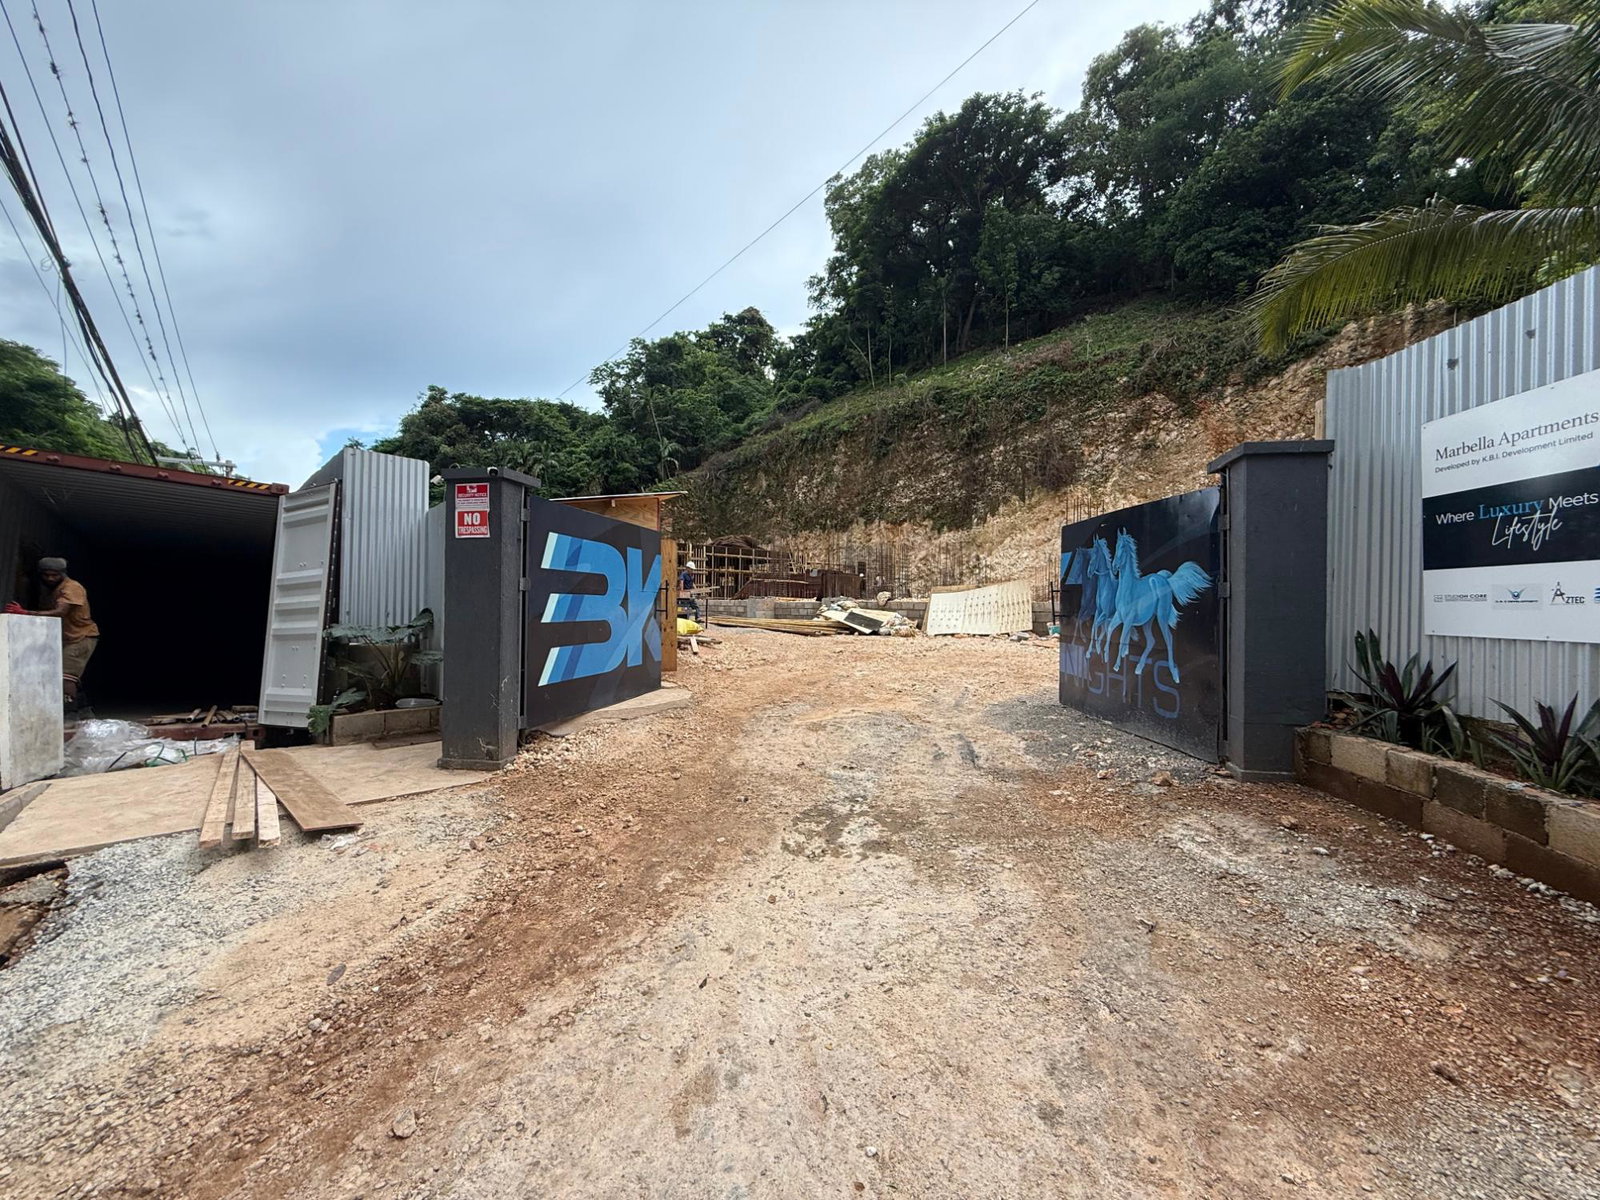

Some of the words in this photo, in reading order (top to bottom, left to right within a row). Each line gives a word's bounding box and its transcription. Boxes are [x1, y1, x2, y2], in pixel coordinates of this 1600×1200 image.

[1434, 460, 1470, 473] Developed
[1502, 440, 1557, 459] Development
[1558, 431, 1594, 446] Limited
[1435, 436, 1495, 461] Marbella
[1498, 411, 1599, 447] Apartments
[463, 512, 481, 526] NO
[1435, 510, 1475, 525] Where
[1479, 500, 1544, 519] Luxury
[1548, 492, 1599, 510] Meets
[1491, 507, 1563, 551] Lifestyle
